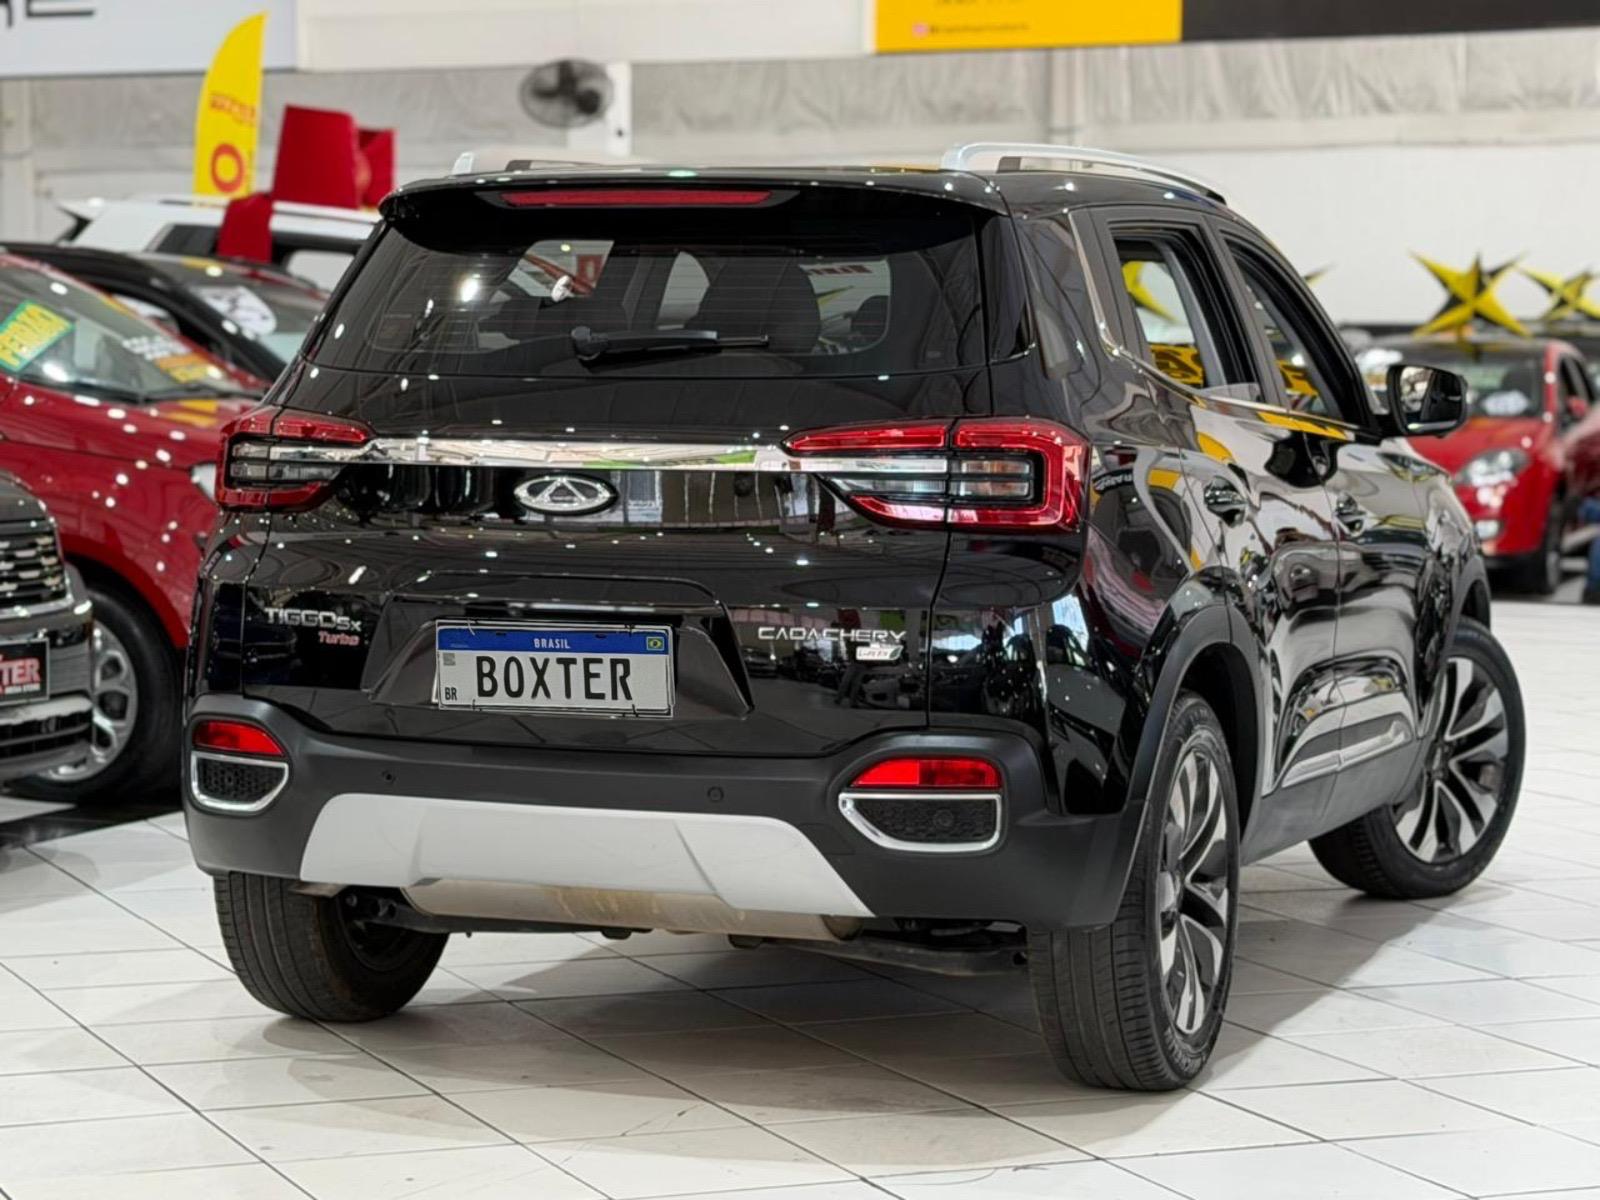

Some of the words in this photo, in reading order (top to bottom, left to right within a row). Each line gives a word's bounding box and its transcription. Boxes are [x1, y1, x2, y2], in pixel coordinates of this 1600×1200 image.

[318, 630, 360, 646] Turbo
[533, 638, 571, 649] BRASIL
[476, 656, 632, 701] BOXTER
[444, 687, 458, 701] BR
